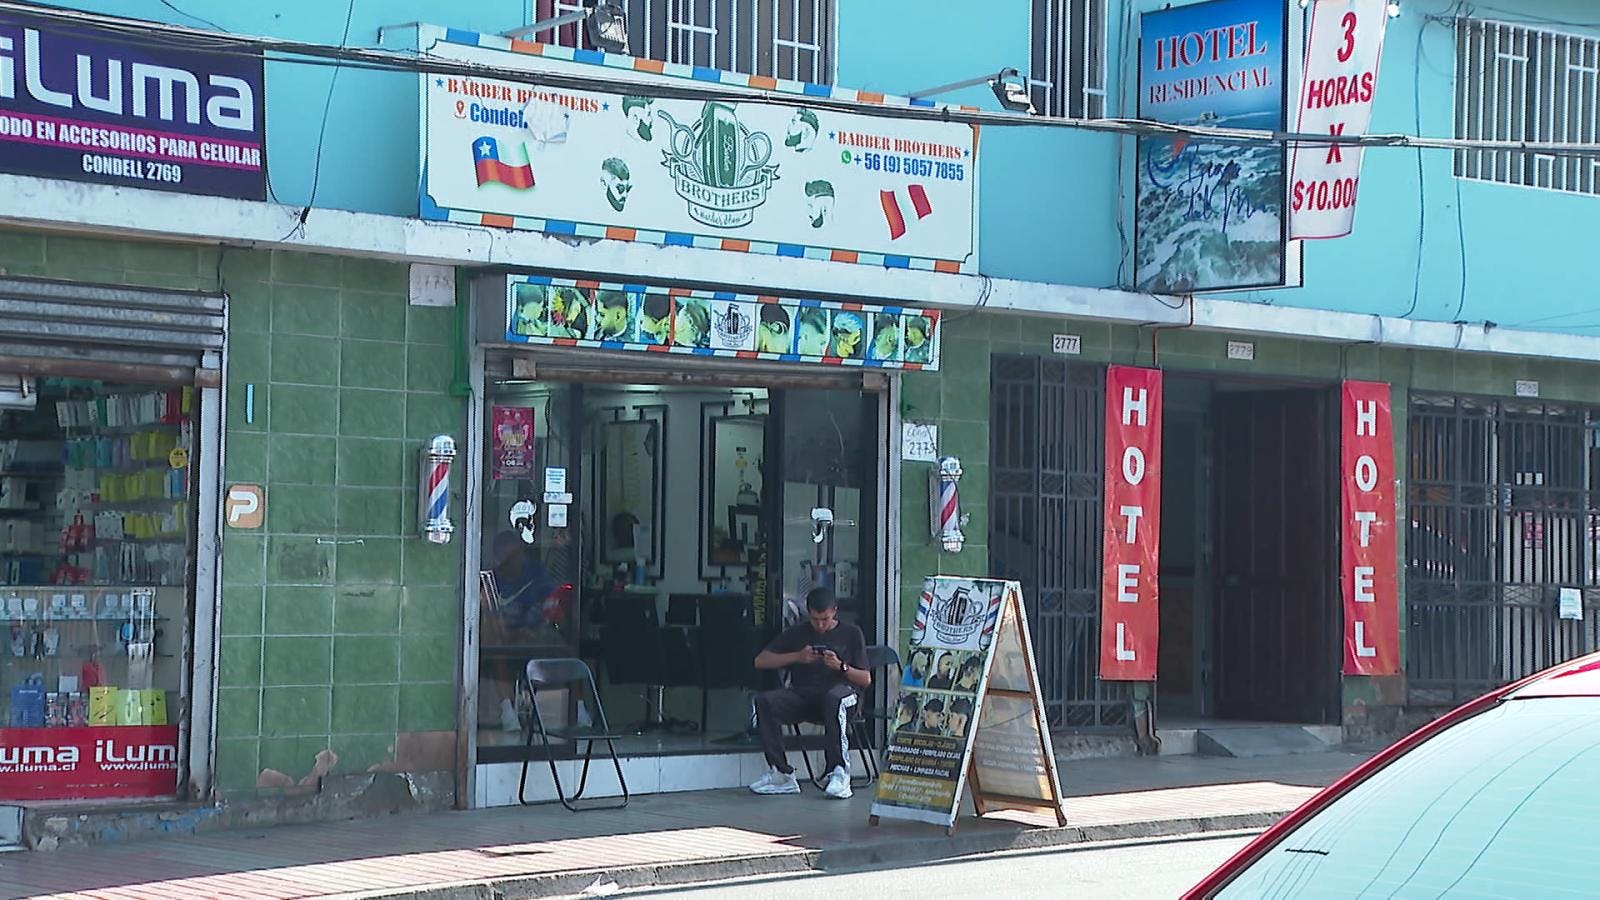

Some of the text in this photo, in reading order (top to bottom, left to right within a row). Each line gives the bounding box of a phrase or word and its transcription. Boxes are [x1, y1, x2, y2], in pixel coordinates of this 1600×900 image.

[1154, 21, 1267, 72] HOTEL
[1337, 11, 1357, 63] 3
[447, 78, 512, 102] BARBER
[1150, 66, 1273, 104] RESIDENCIAL
[1307, 72, 1373, 109] HORAS
[470, 102, 528, 129] Condel
[36, 120, 56, 142] EN
[59, 123, 156, 154] ACCESORIOS
[160, 136, 198, 159] PARA
[200, 142, 261, 167] CELULAR
[838, 131, 962, 160] BARBER BROTHERS
[82, 153, 182, 183] CONDELL 2769
[864, 152, 880, 171] 56
[883, 154, 900, 173] (9)
[903, 157, 933, 178] 5057
[935, 161, 964, 181] 7855
[680, 180, 760, 208] BROTHERS
[1054, 336, 1078, 352] 2777
[1116, 387, 1147, 661] HOTEL
[1355, 400, 1378, 657] HOTEL
